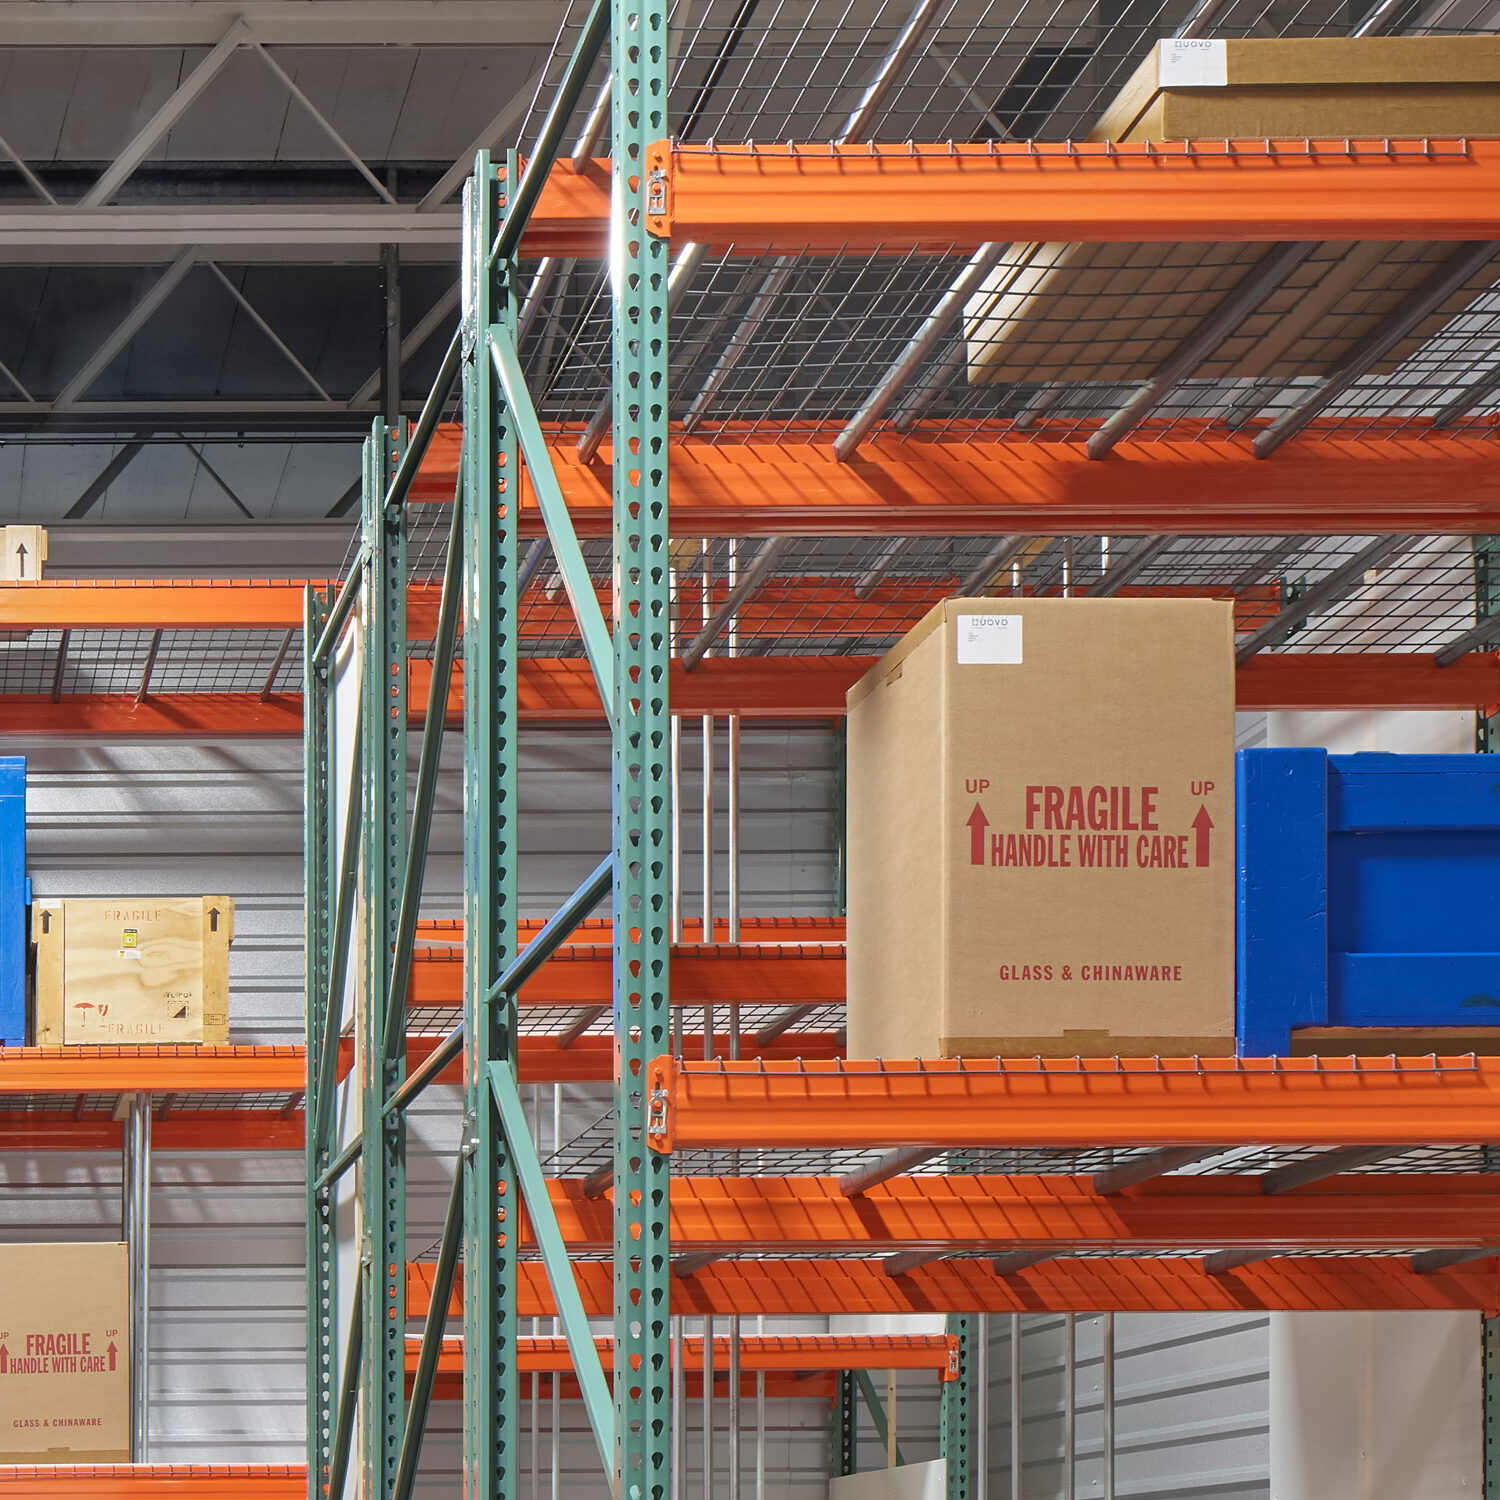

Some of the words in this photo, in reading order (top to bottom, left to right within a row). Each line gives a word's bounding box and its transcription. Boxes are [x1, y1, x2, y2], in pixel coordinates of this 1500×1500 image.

[965, 778, 990, 794] UP
[1190, 781, 1215, 796] UP
[1025, 785, 1159, 831] FRAGILE
[991, 833, 1071, 867] HANDLE
[1078, 834, 1129, 868] WITH
[1136, 835, 1189, 869] CARE
[105, 910, 161, 921] FRAGILE
[1000, 964, 1053, 981] GLASS
[1061, 965, 1073, 981] &
[1081, 964, 1182, 981] CHINAWARE
[108, 1023, 165, 1034] FRAGILE
[106, 1329, 118, 1337] UP
[26, 1333, 91, 1356] FRAGILE
[10, 1357, 49, 1374] HANDLE
[52, 1357, 77, 1373] WITH
[80, 1356, 106, 1372] CARE
[13, 1419, 40, 1428] GLASS
[43, 1419, 49, 1427] &
[53, 1418, 102, 1427] CHINAWARE
